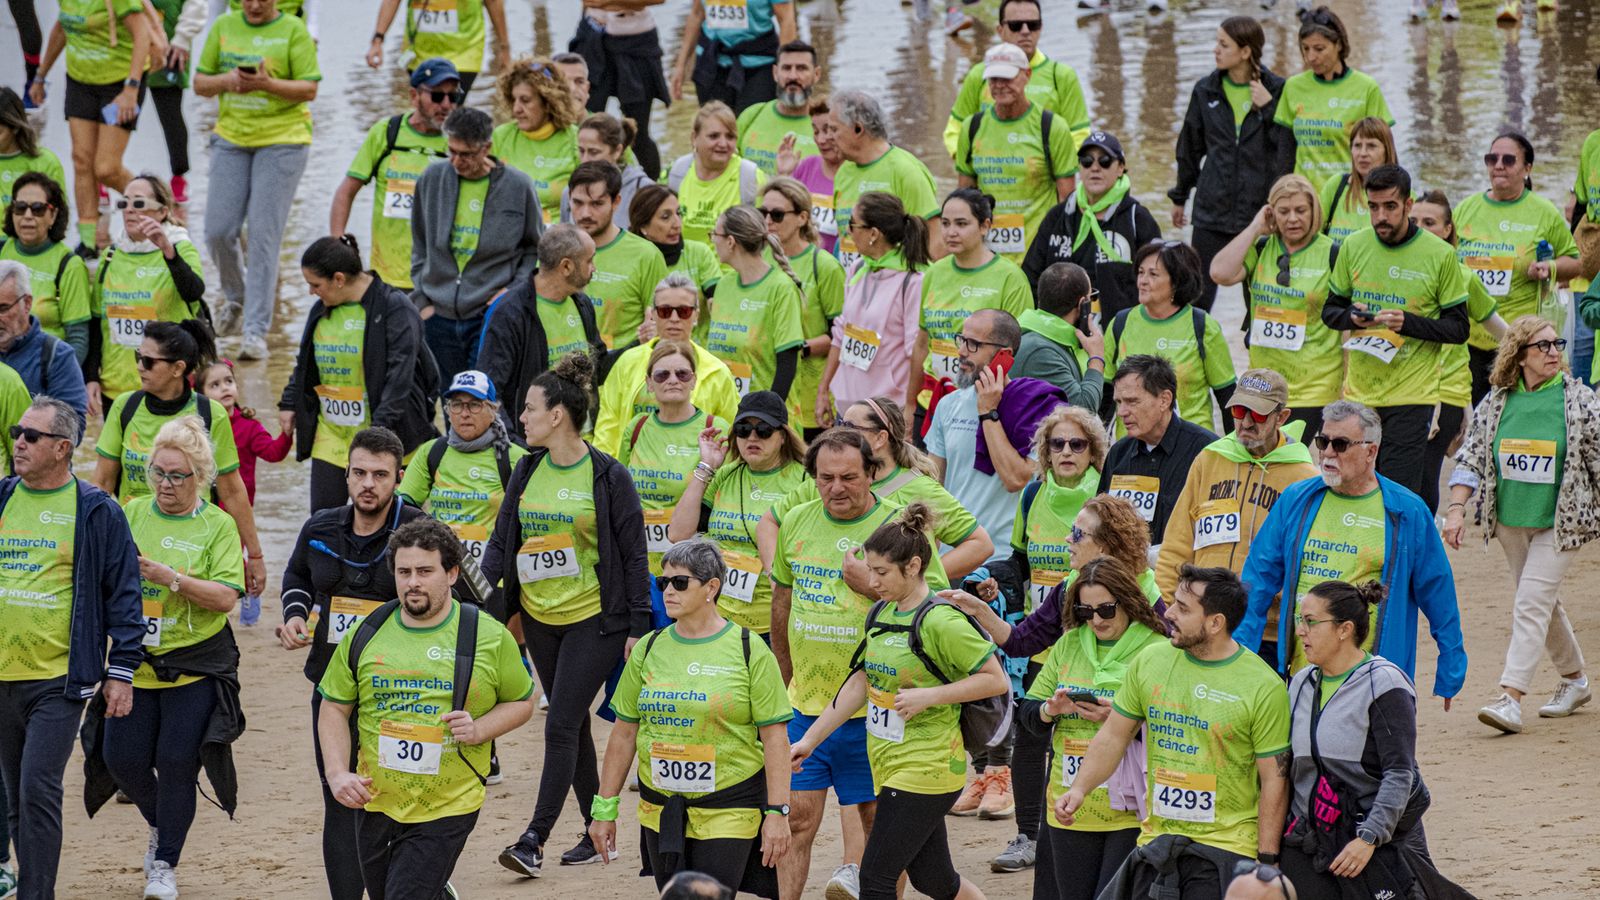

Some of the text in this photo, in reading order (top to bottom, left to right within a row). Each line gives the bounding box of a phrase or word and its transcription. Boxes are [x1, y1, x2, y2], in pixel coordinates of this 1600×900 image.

[424, 11, 450, 24] 671
[708, 5, 745, 20] 4533
[392, 193, 413, 209] 23
[985, 227, 1022, 243] 299
[1473, 241, 1514, 251] marcha
[111, 291, 151, 299] marcha
[1263, 284, 1305, 298] marcha
[1363, 290, 1406, 305] marcha
[1263, 321, 1297, 340] 835
[845, 337, 876, 361] 4680
[325, 398, 362, 417] 2009
[1506, 453, 1553, 472] 4677
[637, 469, 683, 481] marcha
[442, 489, 488, 501] marcha
[527, 511, 574, 524] marcha
[8, 537, 57, 549] marcha
[1308, 538, 1358, 554] marcha
[529, 549, 567, 571] 799
[1029, 555, 1064, 564] contra
[724, 568, 750, 590] 01
[805, 623, 858, 636] HYUNDAI
[372, 675, 453, 691] En marcha
[652, 689, 707, 702] marcha
[649, 713, 695, 727] cáncer
[871, 705, 890, 728] 31
[1148, 706, 1209, 730] En marcha
[396, 739, 424, 762] 30
[1157, 737, 1199, 755] cáncer
[658, 759, 712, 781] 3082
[1158, 786, 1213, 811] 4293
